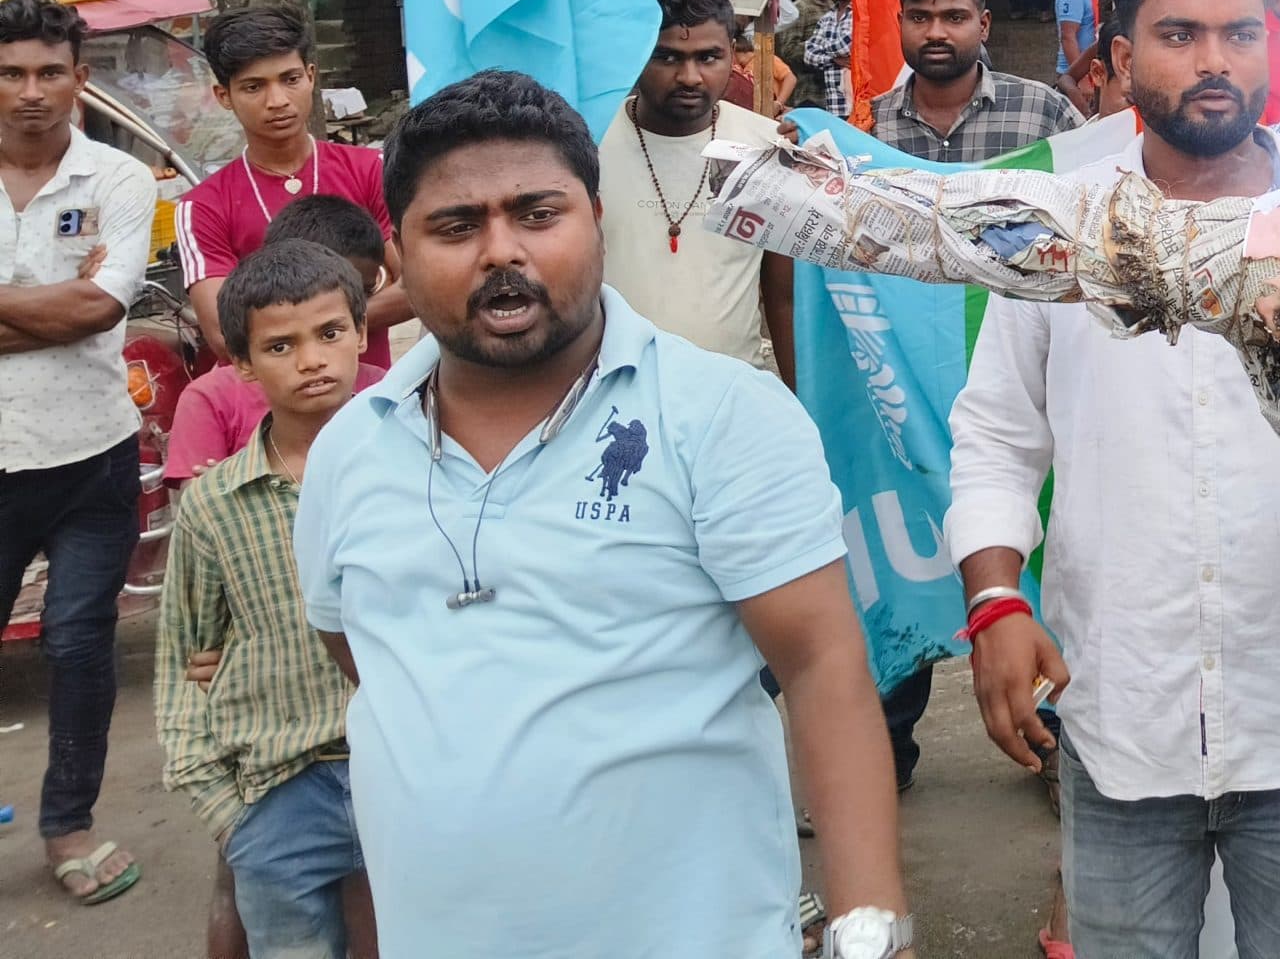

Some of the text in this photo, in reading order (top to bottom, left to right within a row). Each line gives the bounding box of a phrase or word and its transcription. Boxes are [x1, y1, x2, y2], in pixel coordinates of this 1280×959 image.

[637, 200, 680, 209] COTON
[795, 218, 819, 244] बिहार
[808, 206, 823, 219] में
[575, 500, 630, 522] USPA
